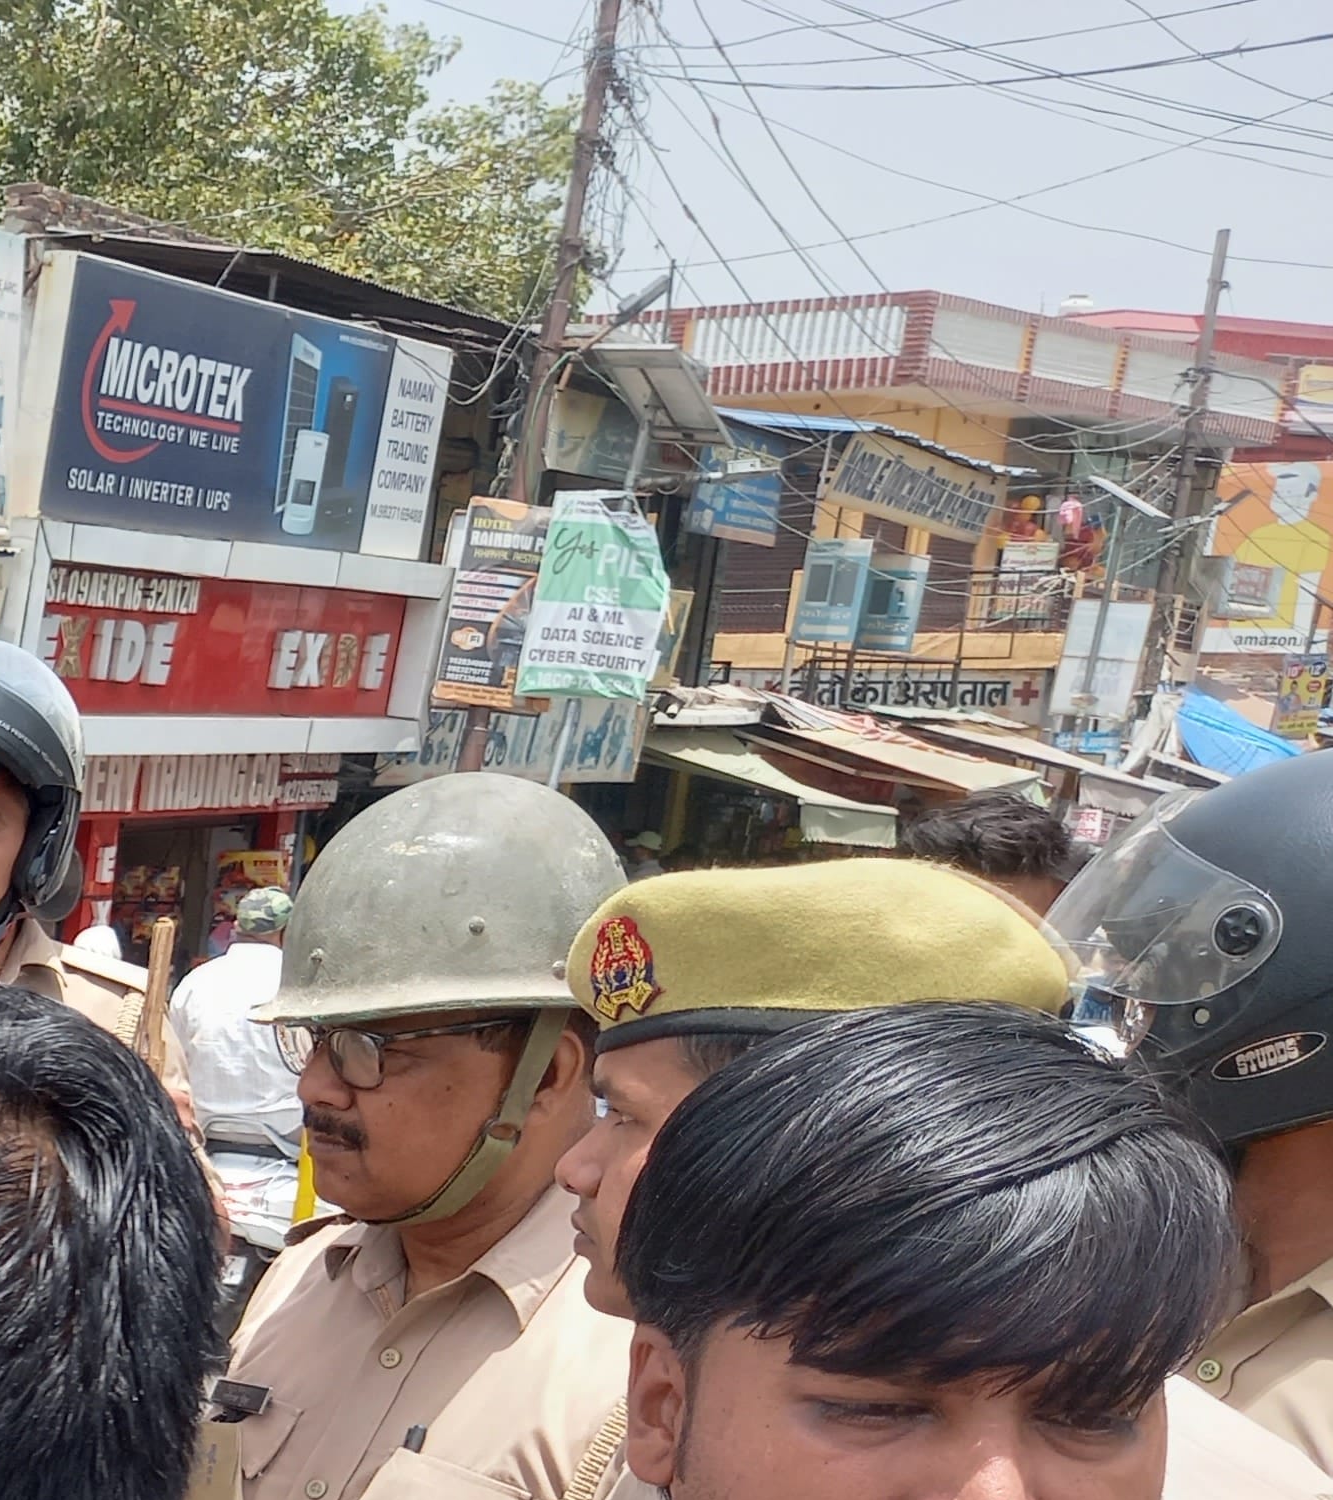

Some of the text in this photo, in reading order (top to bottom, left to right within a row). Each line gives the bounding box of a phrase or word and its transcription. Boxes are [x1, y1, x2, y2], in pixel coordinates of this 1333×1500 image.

[100, 336, 253, 422] MICROTEK
[398, 377, 435, 404] NAMAN
[97, 411, 240, 454] TECHNOLOGY WE LIVE
[391, 408, 435, 434] BATTERY
[387, 440, 429, 465] TRADING
[68, 467, 231, 512] SOLAR INVERTER UPS
[377, 470, 427, 495] COMPANY
[473, 516, 513, 531] HOTEL
[470, 530, 534, 551] RAINBOW
[584, 585, 621, 605] CSE
[567, 607, 624, 625] AI & ML
[541, 627, 645, 650] DATA SCIENCE
[528, 648, 647, 673] CYBER SECURITY
[142, 754, 249, 812] TRADING
[1236, 1036, 1300, 1076] STUDDS
